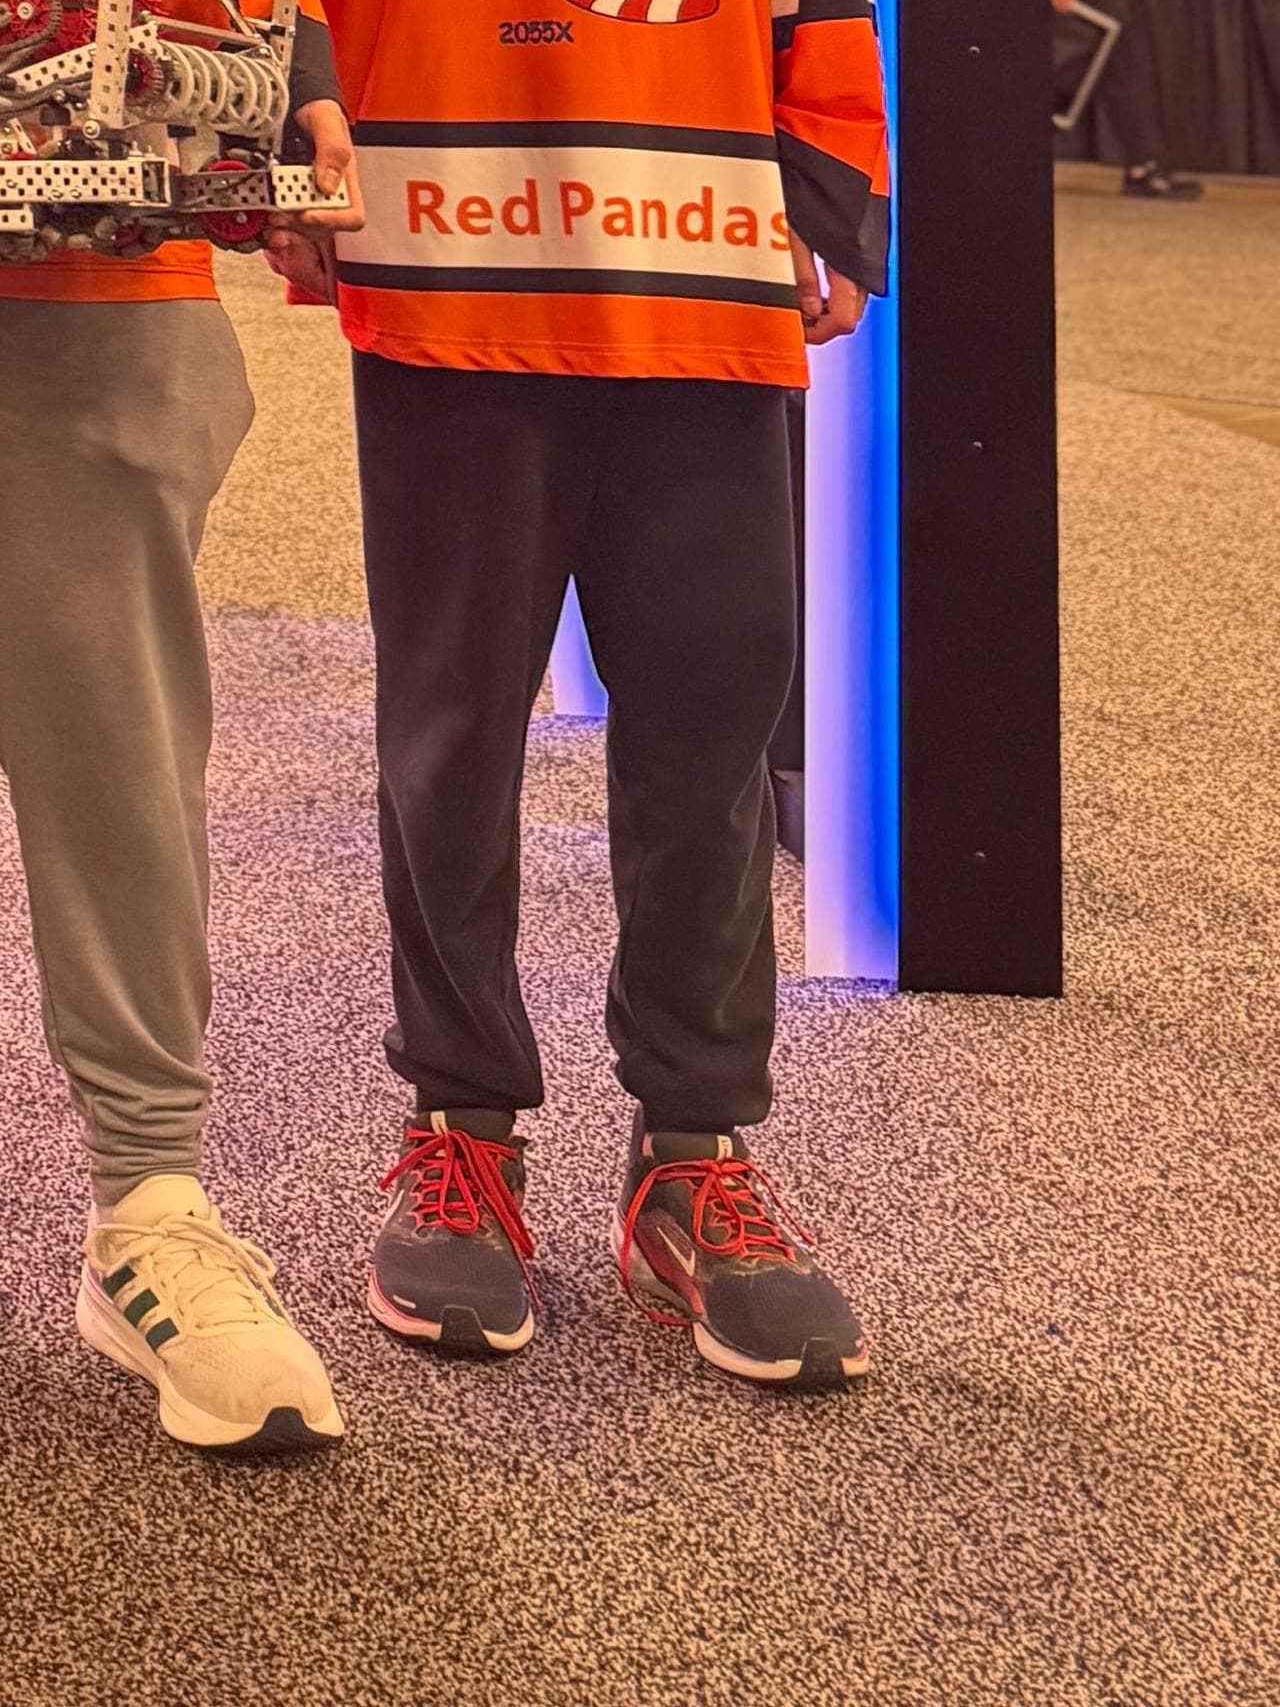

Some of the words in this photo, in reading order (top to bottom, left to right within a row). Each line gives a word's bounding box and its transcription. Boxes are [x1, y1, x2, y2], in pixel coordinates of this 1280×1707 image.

[497, 20, 575, 44] 2055X
[406, 179, 541, 235] Red
[559, 181, 790, 251] Pandas
